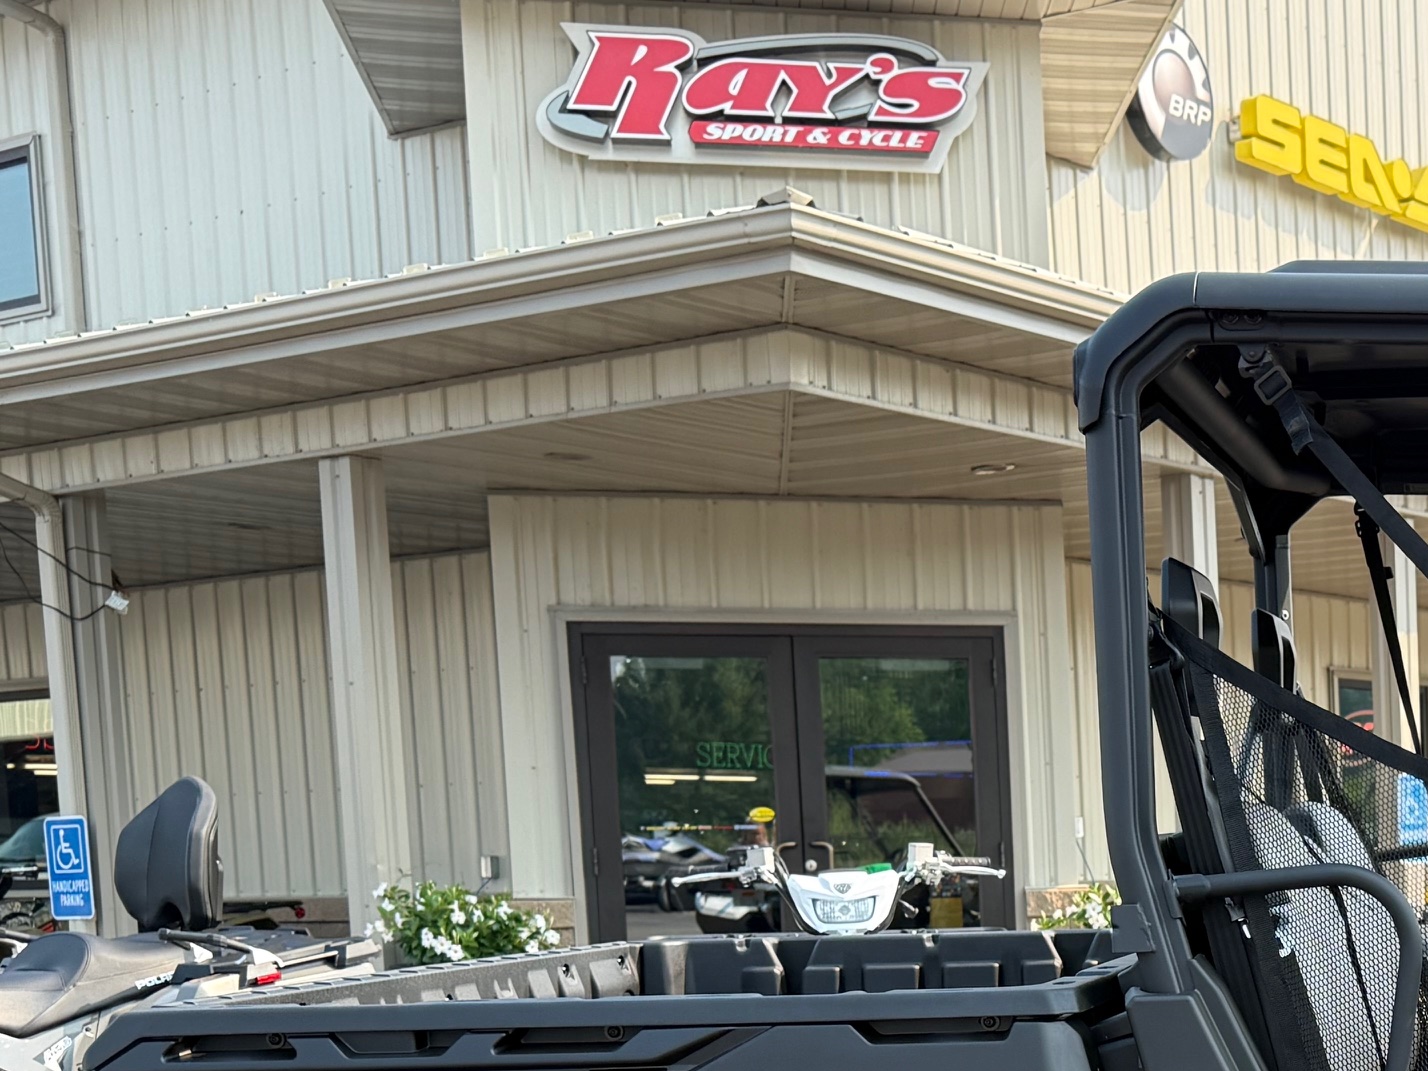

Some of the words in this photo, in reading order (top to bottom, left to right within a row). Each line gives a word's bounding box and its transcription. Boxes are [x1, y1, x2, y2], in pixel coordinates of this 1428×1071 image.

[1168, 93, 1212, 126] BRP
[702, 122, 802, 145] SPORT
[806, 126, 829, 145] &
[838, 127, 926, 149] CYCLE
[696, 741, 774, 769] SERVIC
[52, 879, 89, 893] HANDICAPPED
[60, 893, 84, 907] PARKING
